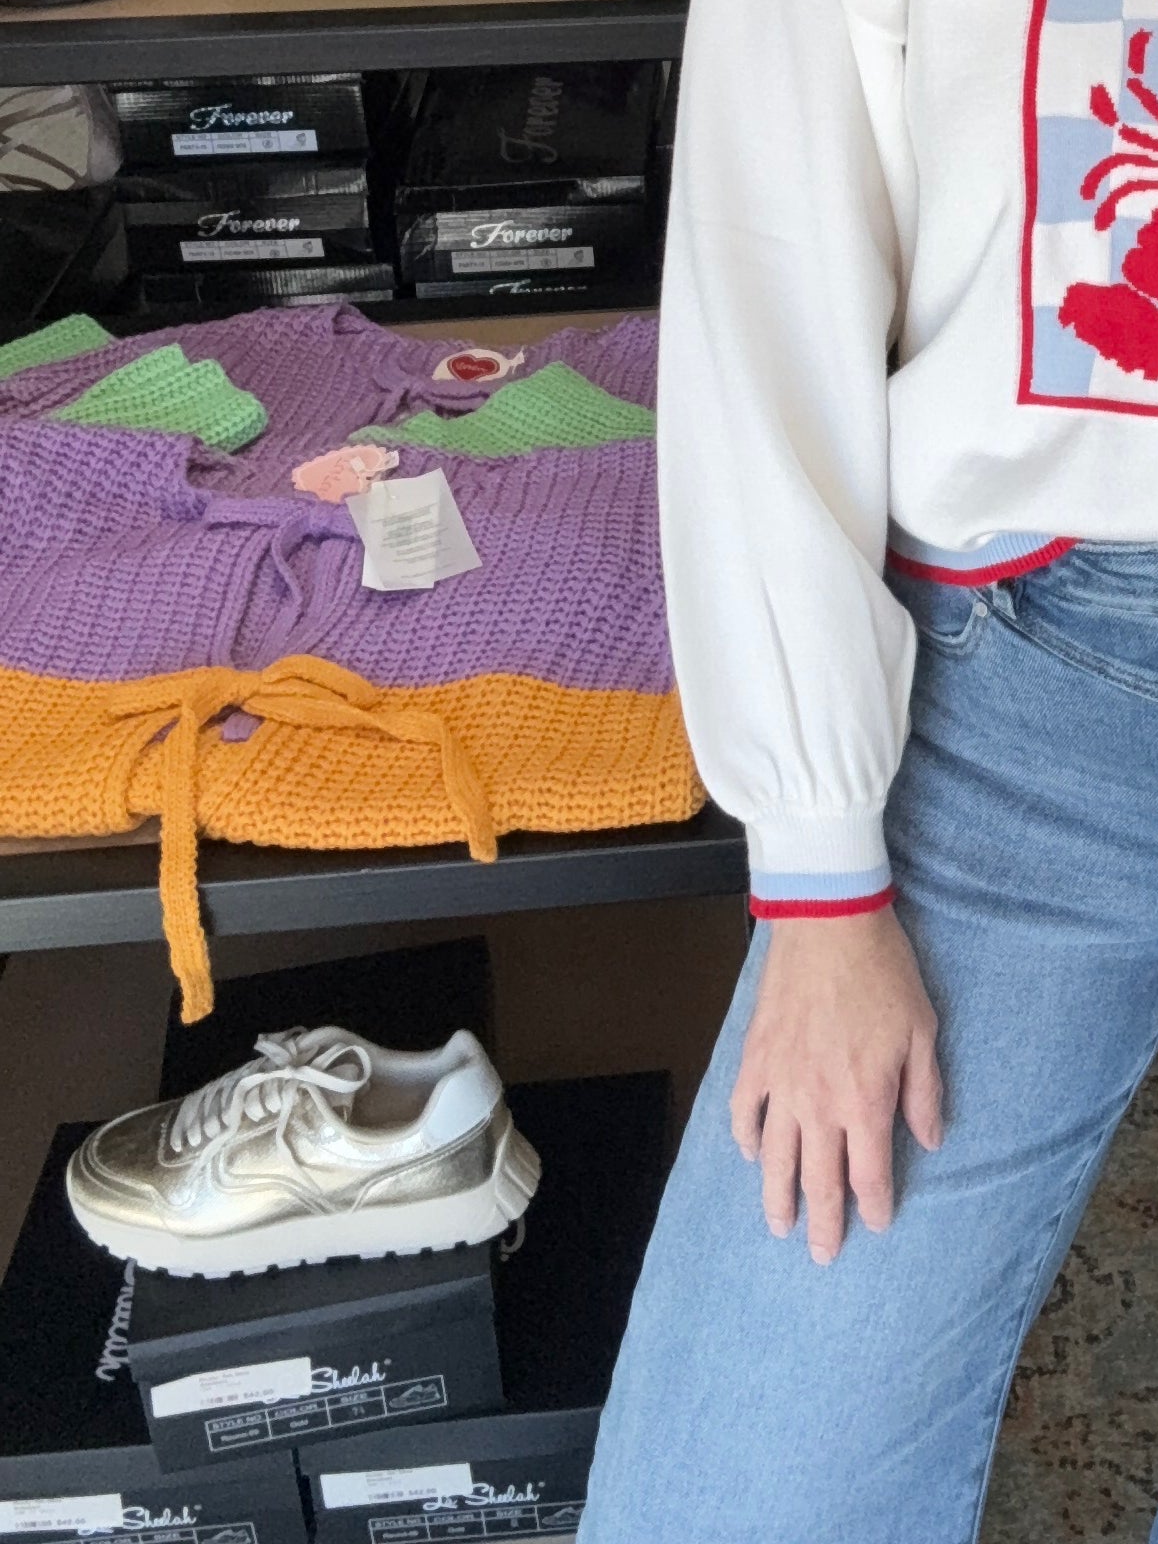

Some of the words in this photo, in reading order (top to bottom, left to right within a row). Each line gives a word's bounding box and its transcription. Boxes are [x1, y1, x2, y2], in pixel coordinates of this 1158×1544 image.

[189, 103, 294, 131] Forever
[497, 76, 564, 163] Forever
[197, 209, 301, 237] Forever
[470, 219, 573, 249] Forever
[310, 1361, 386, 1393] Sheelah
[464, 1482, 540, 1506] Sheelah
[122, 1505, 197, 1529] Sheelah
